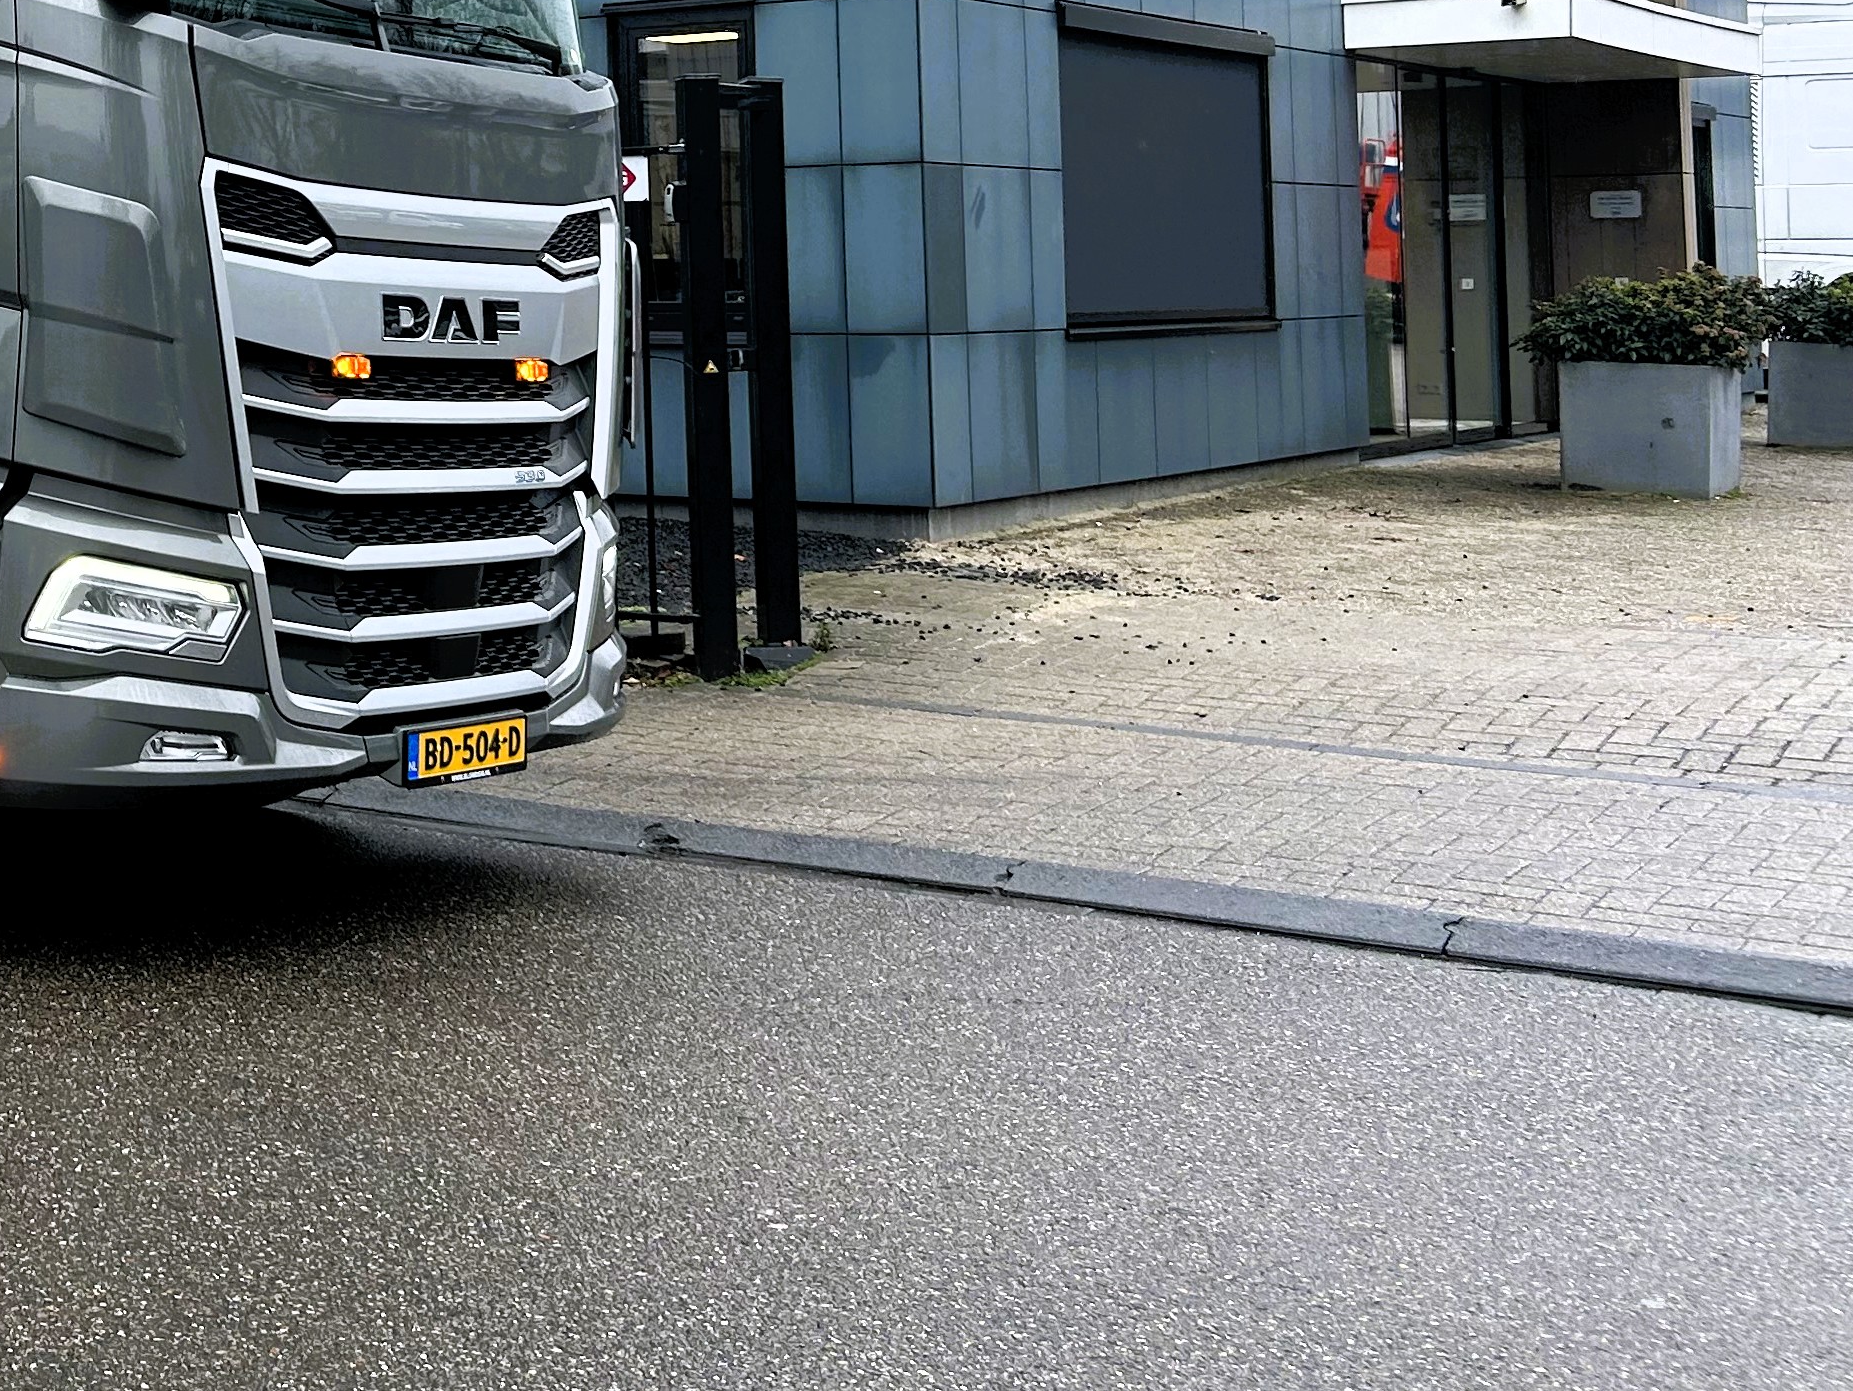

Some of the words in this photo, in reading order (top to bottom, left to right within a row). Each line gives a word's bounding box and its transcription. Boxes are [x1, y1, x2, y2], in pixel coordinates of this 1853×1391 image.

[380, 292, 521, 345] DAF
[408, 761, 418, 772] NL
[424, 725, 521, 771] BD-504-D
